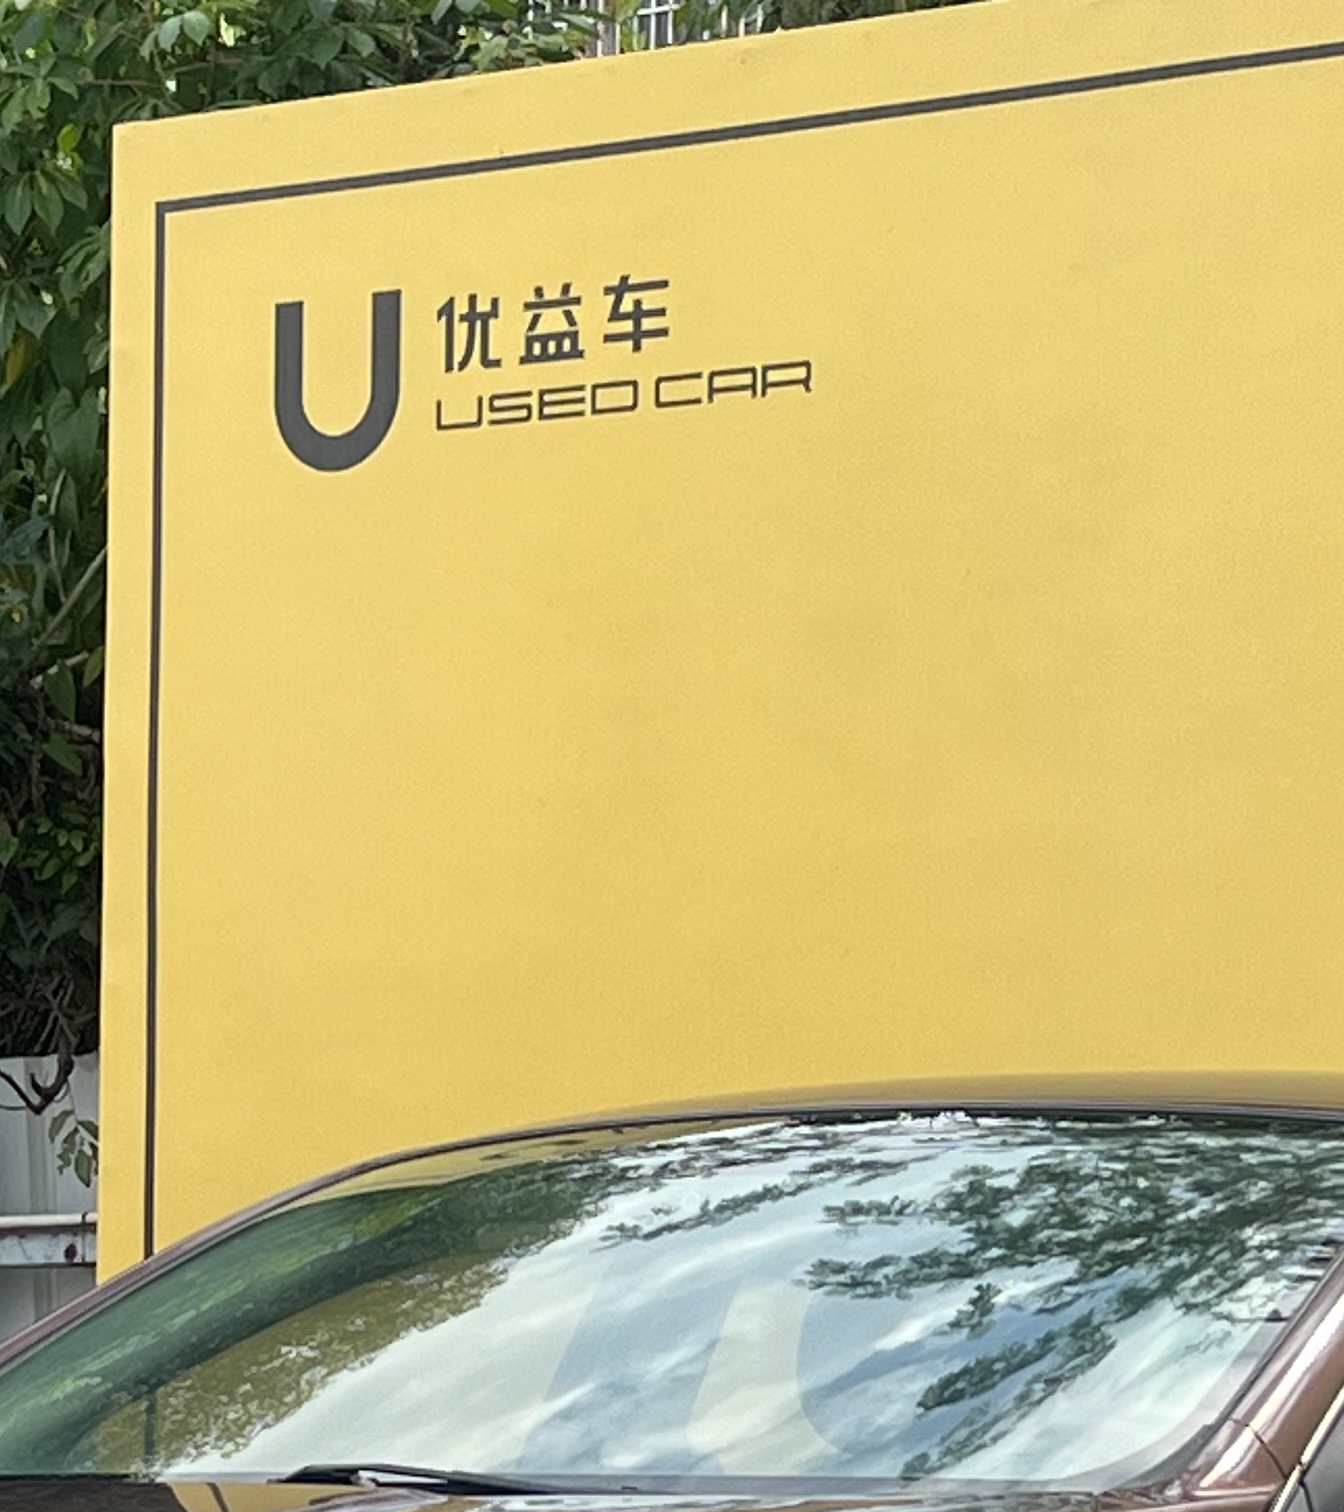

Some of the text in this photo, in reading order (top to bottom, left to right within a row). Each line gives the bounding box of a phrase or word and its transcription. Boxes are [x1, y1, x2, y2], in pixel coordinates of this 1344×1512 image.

[436, 275, 670, 374] 优益车
[275, 289, 402, 472] U
[436, 360, 812, 431] USED CAR
